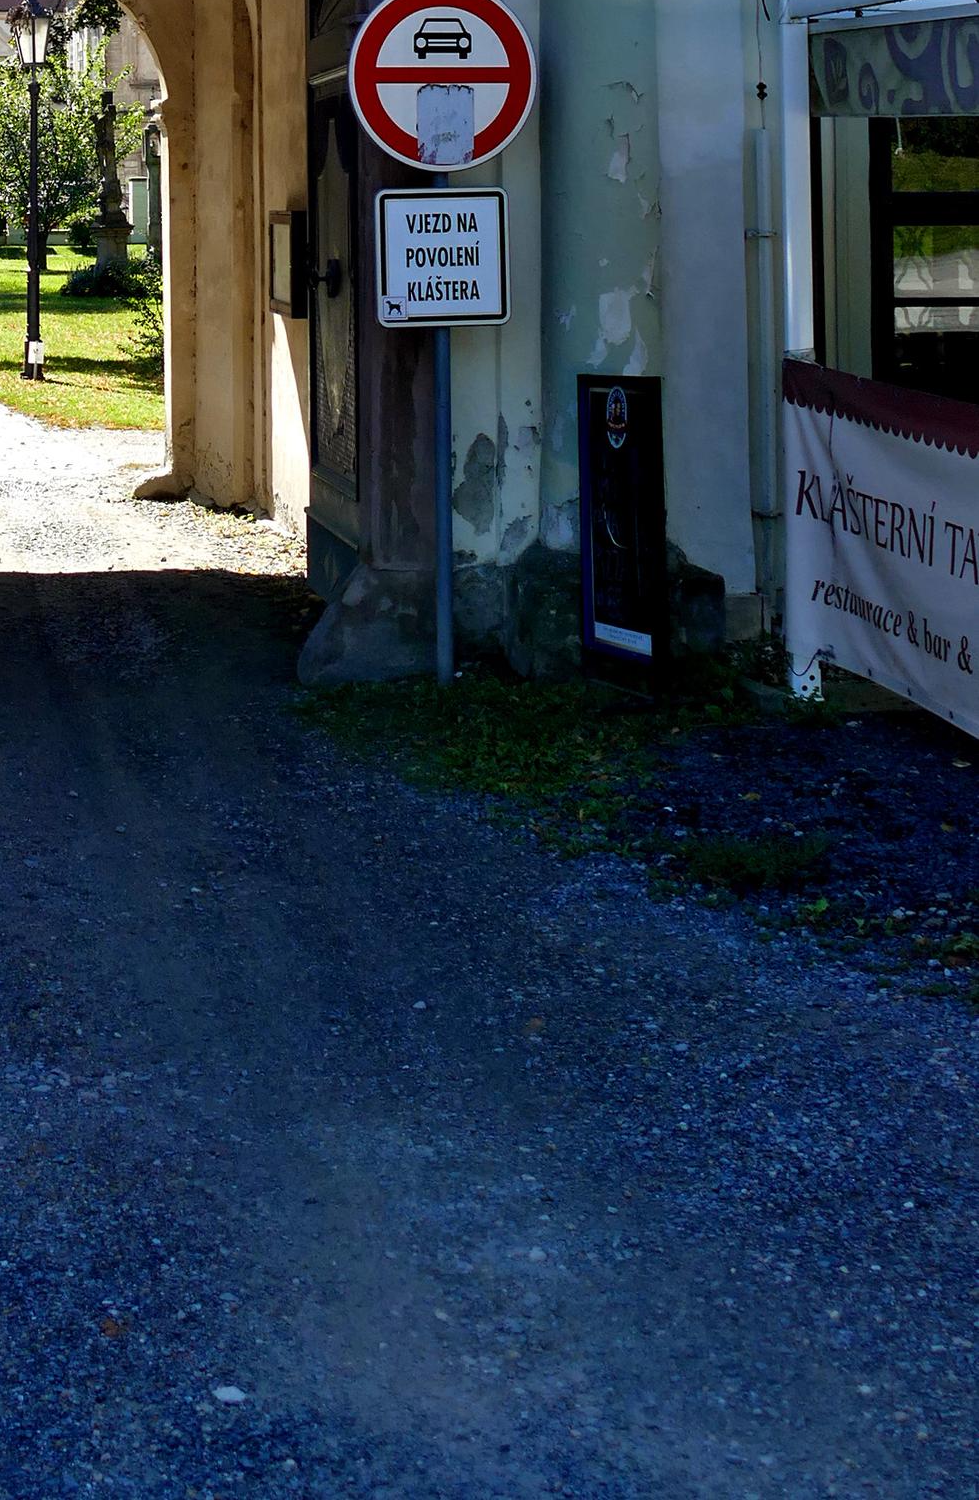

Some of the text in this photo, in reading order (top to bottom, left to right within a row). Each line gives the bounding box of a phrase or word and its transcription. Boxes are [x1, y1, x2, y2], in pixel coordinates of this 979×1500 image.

[405, 212, 478, 234] VJEZD NA
[405, 240, 480, 268] POVOLENÍ
[407, 275, 481, 302] KLÁŠTERA
[795, 469, 979, 586] KLÁŠTERNÍ TA
[811, 579, 973, 675] restaurace & bar &
